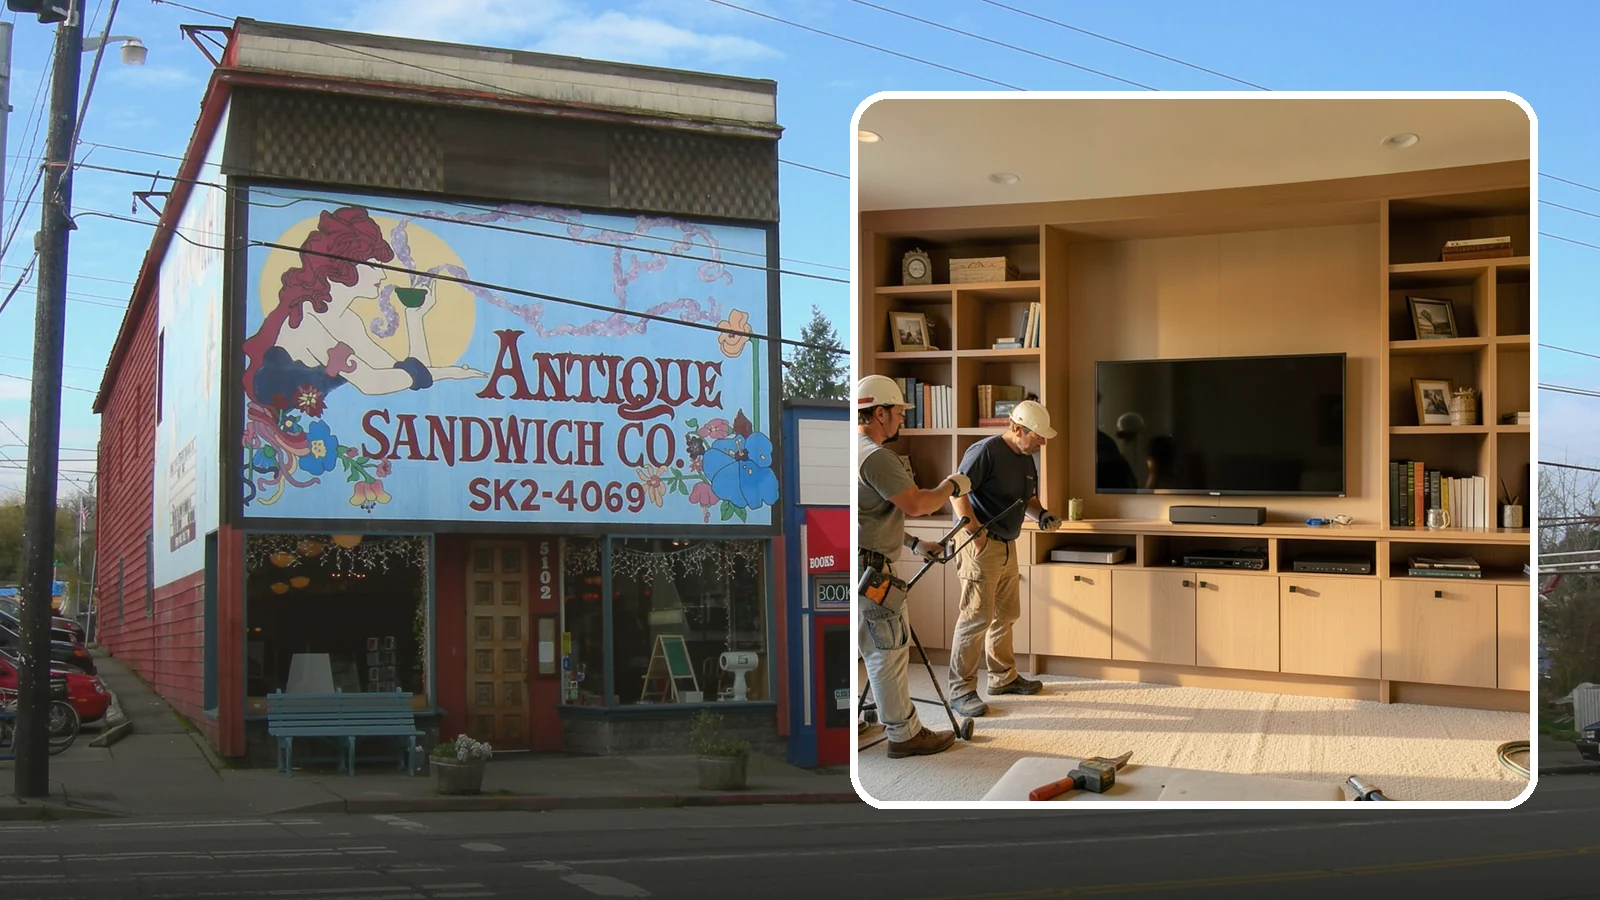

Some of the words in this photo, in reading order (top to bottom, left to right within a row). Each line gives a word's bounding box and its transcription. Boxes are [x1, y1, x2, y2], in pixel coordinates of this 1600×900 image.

[475, 328, 724, 421] ANTIQUE
[361, 408, 605, 467] SANDWICH
[616, 421, 685, 469] CO.
[468, 476, 645, 513] SK2-4069
[540, 541, 552, 600] 5102
[809, 555, 835, 569] BOOKS
